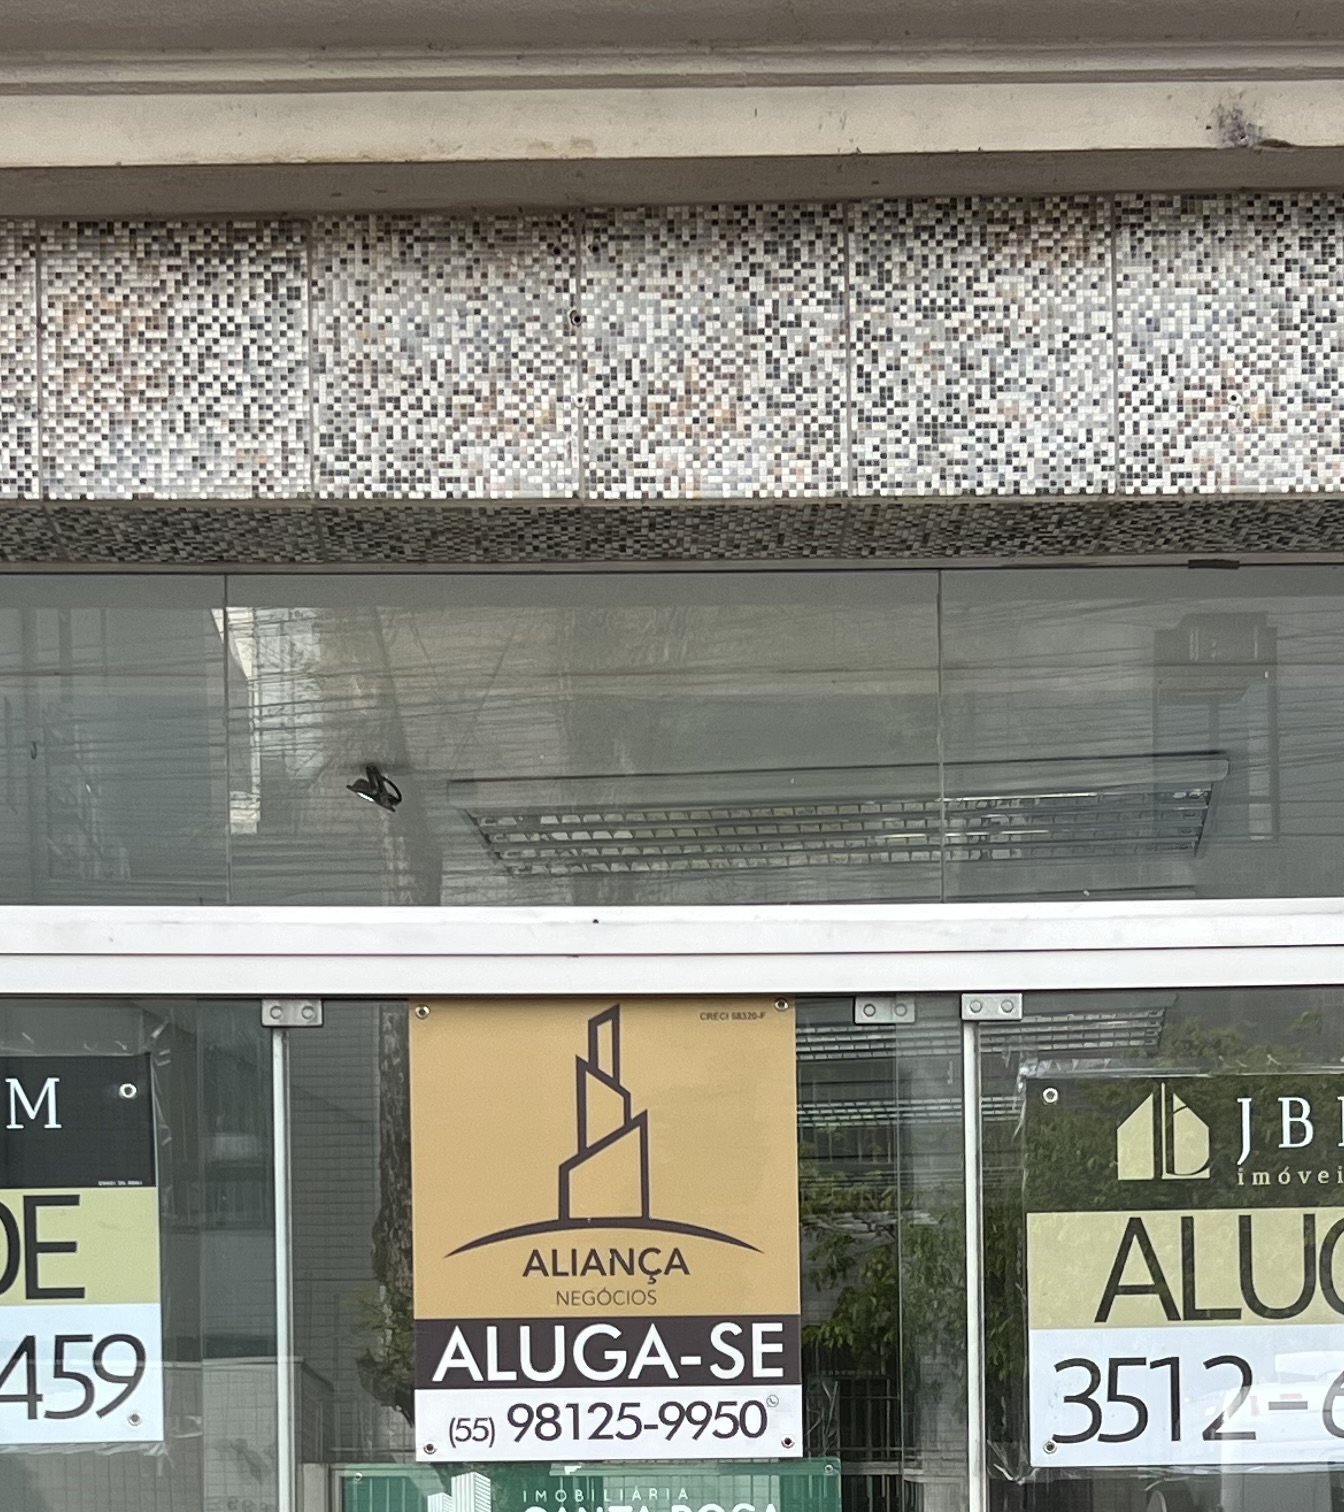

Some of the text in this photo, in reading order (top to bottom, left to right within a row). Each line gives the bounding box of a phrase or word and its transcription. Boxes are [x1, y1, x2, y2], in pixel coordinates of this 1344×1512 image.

[522, 1246, 690, 1284] ALIANÇA
[555, 1286, 658, 1307] NEGÓCIOS
[431, 1321, 785, 1383] ALUGA-SE
[448, 1399, 768, 1449] (55) 98125-9950
[522, 1485, 689, 1503] IMOBILIÁRIA
